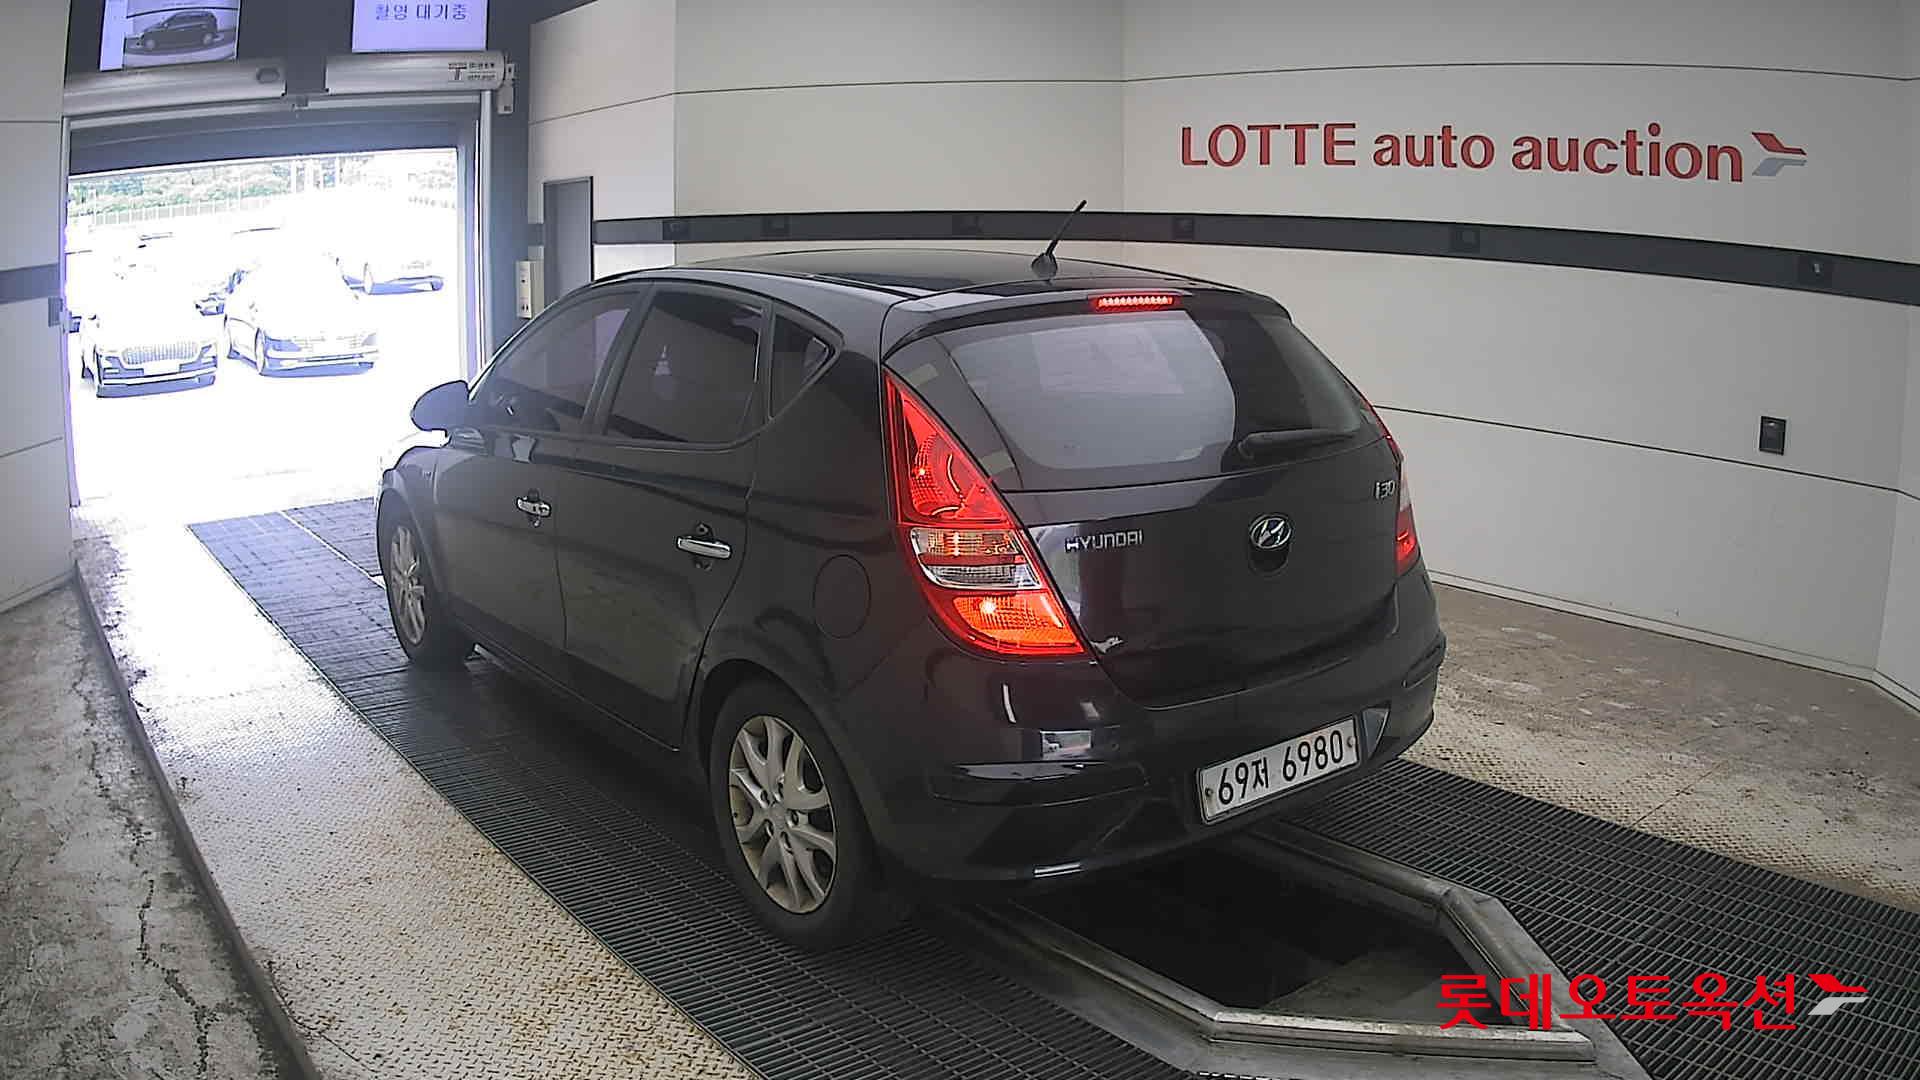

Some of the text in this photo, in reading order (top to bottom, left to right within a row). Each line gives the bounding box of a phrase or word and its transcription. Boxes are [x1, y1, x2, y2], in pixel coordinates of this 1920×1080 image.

[416, 3, 467, 20] 대기중
[1180, 122, 1743, 183] LOTTE auto auction
[1375, 480, 1396, 500] i30
[1065, 529, 1143, 552] HYUNDAI
[1218, 730, 1343, 805] 69저 6980
